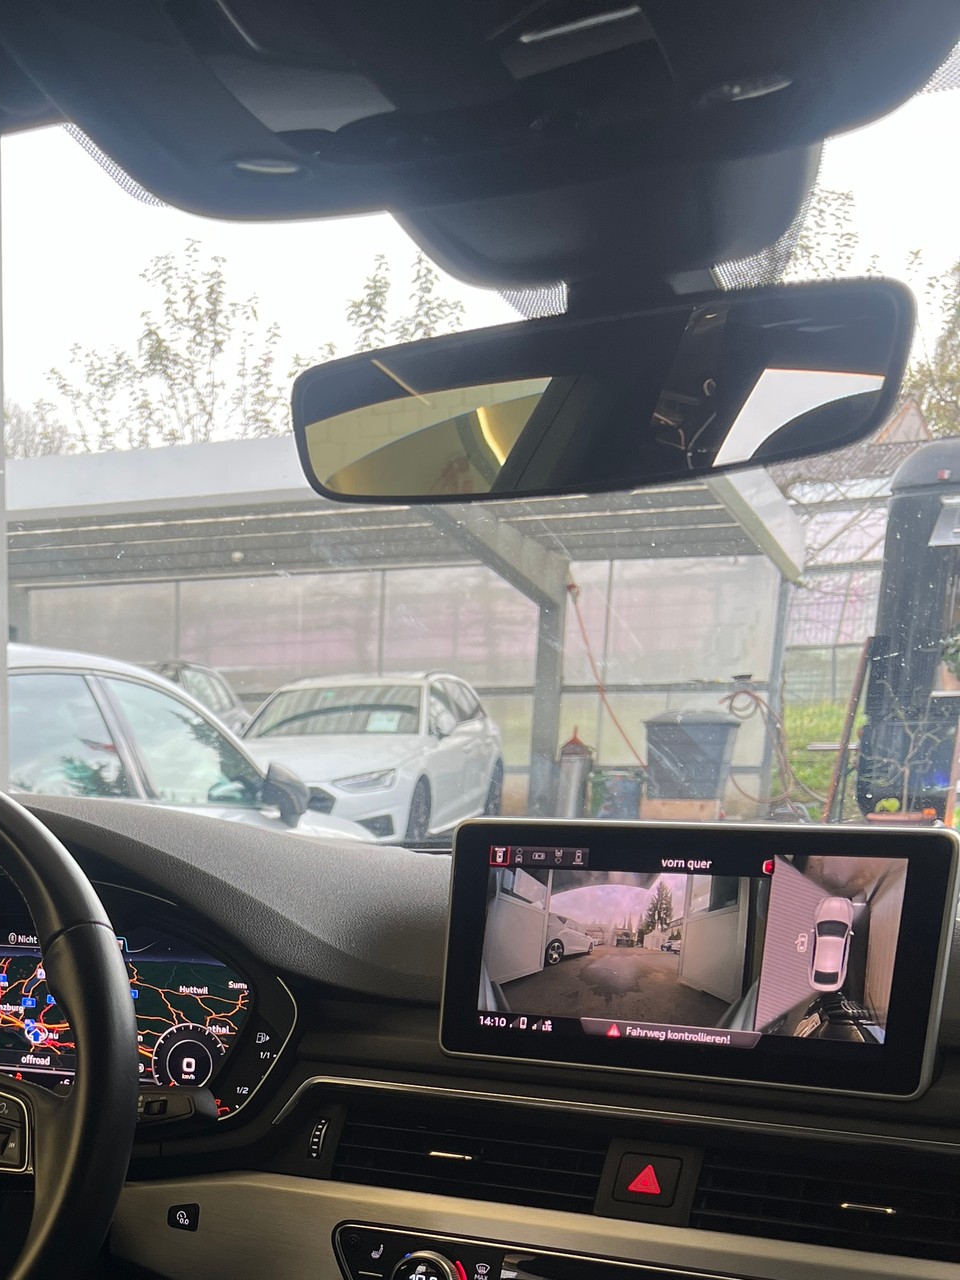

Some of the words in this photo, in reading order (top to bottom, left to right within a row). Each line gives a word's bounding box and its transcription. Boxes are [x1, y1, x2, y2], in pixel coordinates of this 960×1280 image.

[661, 858, 685, 868] vorn
[687, 860, 713, 871] quer
[17, 934, 38, 944] Nicht
[179, 985, 208, 994] Huttwil
[478, 1015, 507, 1028] 14:10
[626, 1026, 666, 1041] Fahrweg
[667, 1029, 731, 1045] kontrollieren!
[21, 1054, 51, 1066] offroad
[259, 1051, 271, 1059] 1/1
[182, 1057, 196, 1073] 0
[236, 1086, 249, 1095] 1/2
